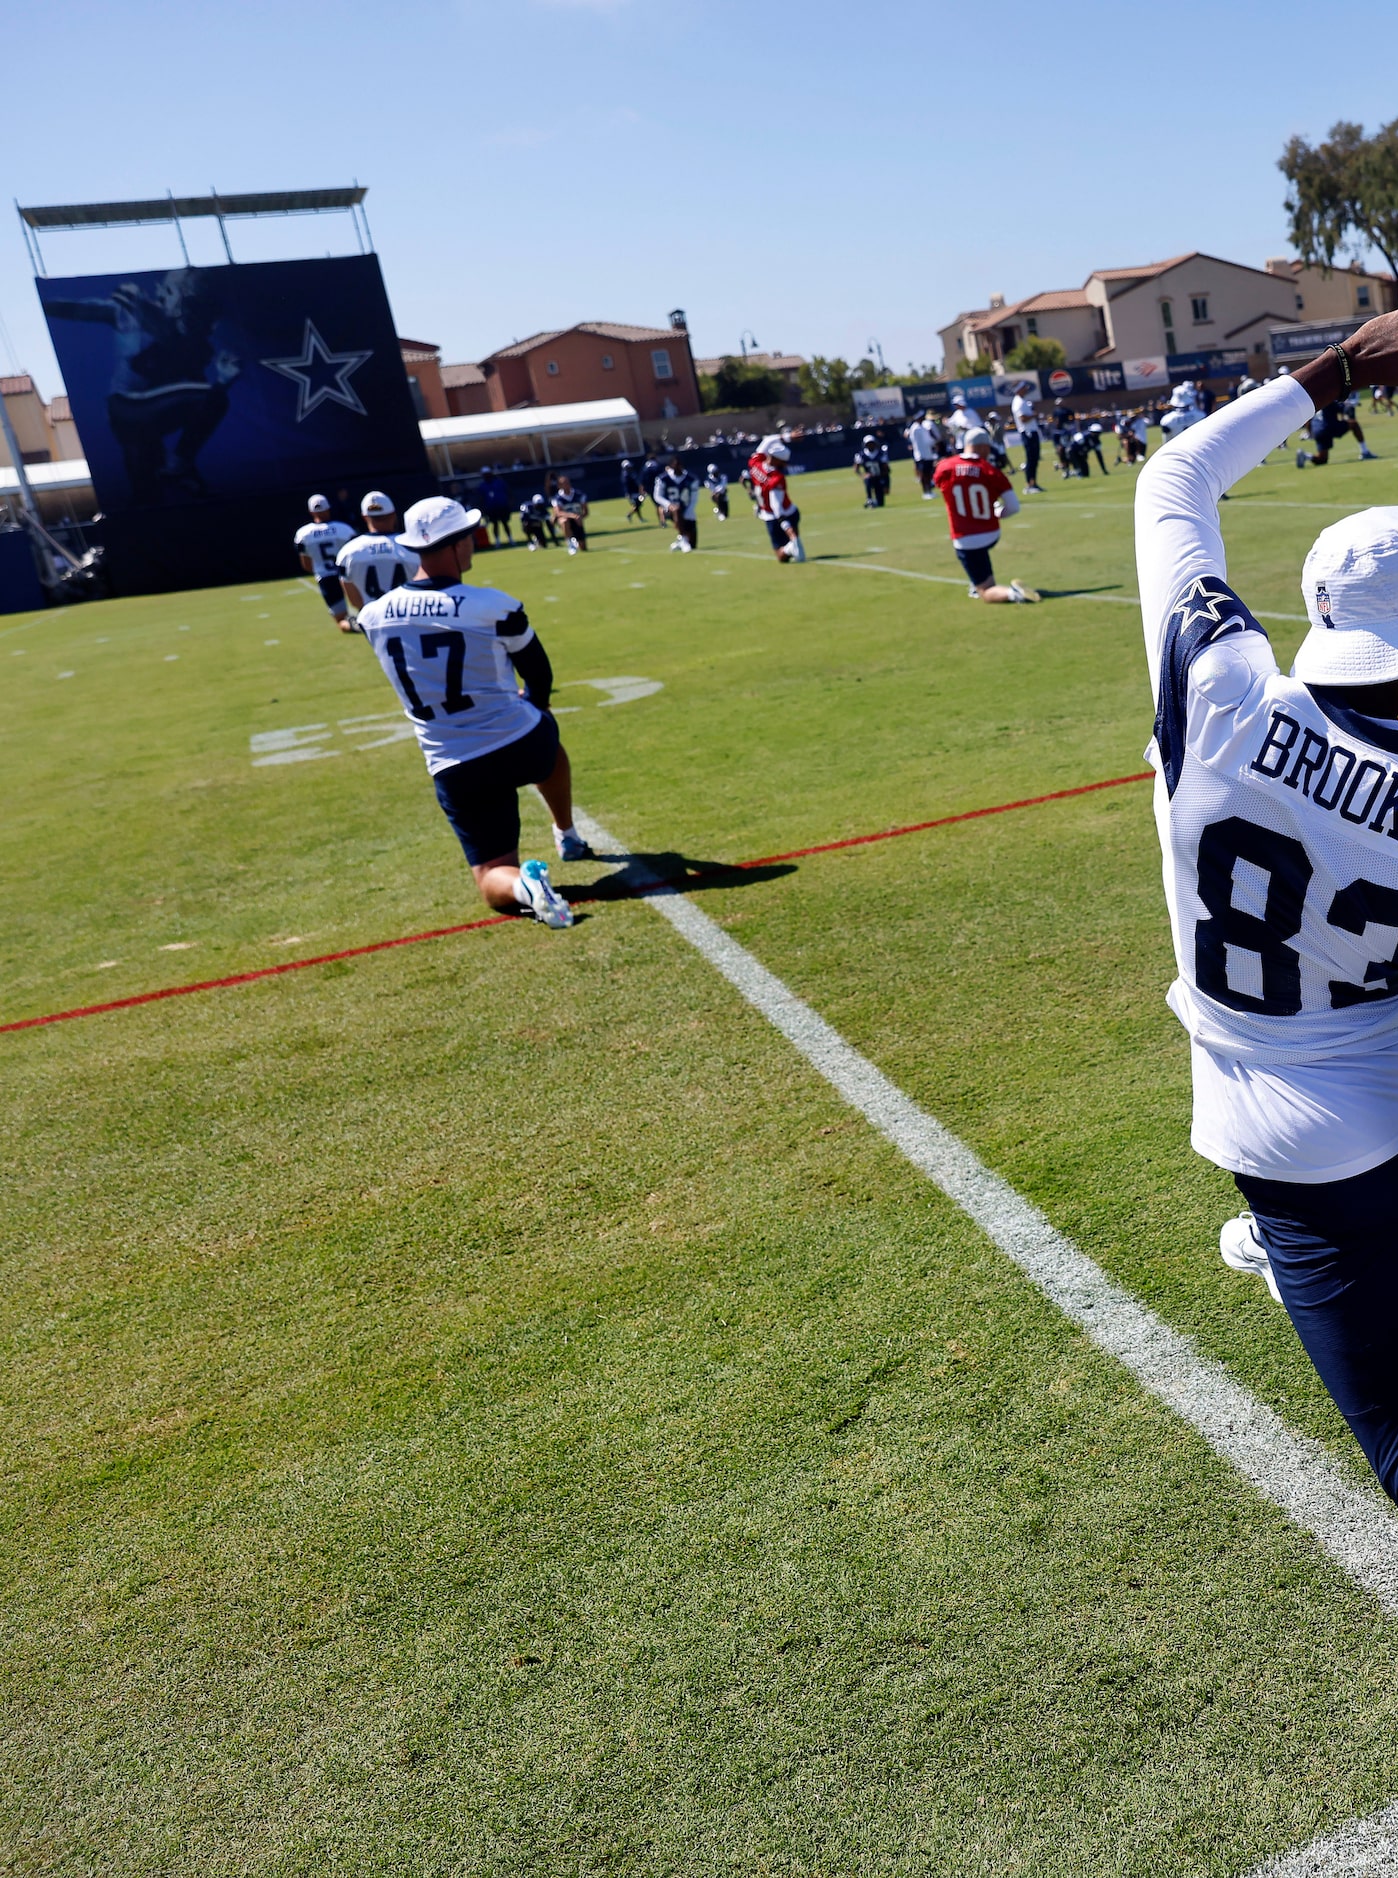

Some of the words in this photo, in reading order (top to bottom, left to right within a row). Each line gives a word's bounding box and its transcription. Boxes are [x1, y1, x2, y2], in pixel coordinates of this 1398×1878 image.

[952, 483, 991, 520] 10
[319, 542, 338, 571] 5
[384, 595, 466, 619] AUBREY
[387, 631, 475, 720] 17
